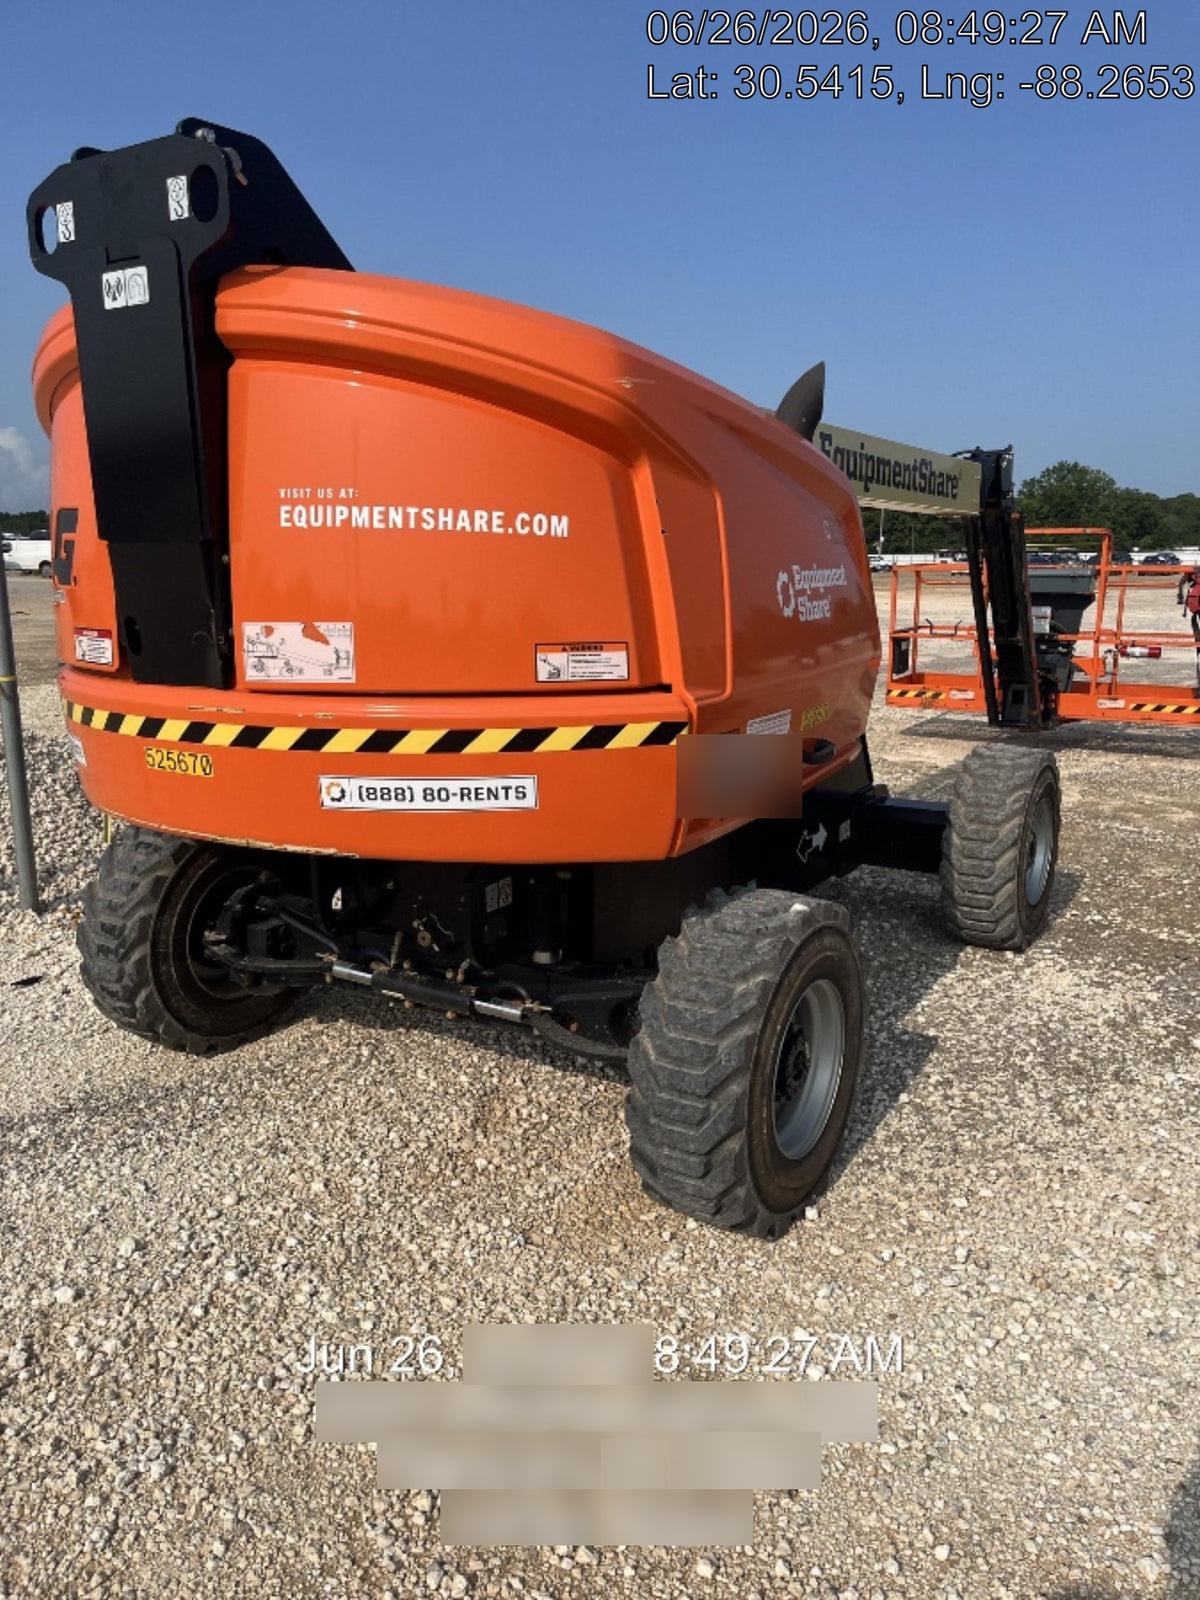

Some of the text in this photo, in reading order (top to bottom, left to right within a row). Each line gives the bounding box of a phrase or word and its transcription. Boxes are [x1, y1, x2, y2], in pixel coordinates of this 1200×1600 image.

[279, 488, 359, 499] VISIT US AT:
[279, 504, 569, 538] EQUIPMENTSHARE.COM
[792, 563, 847, 593] Equipment
[798, 597, 831, 622] Share
[146, 748, 213, 776] 525670
[358, 786, 414, 803] (888)
